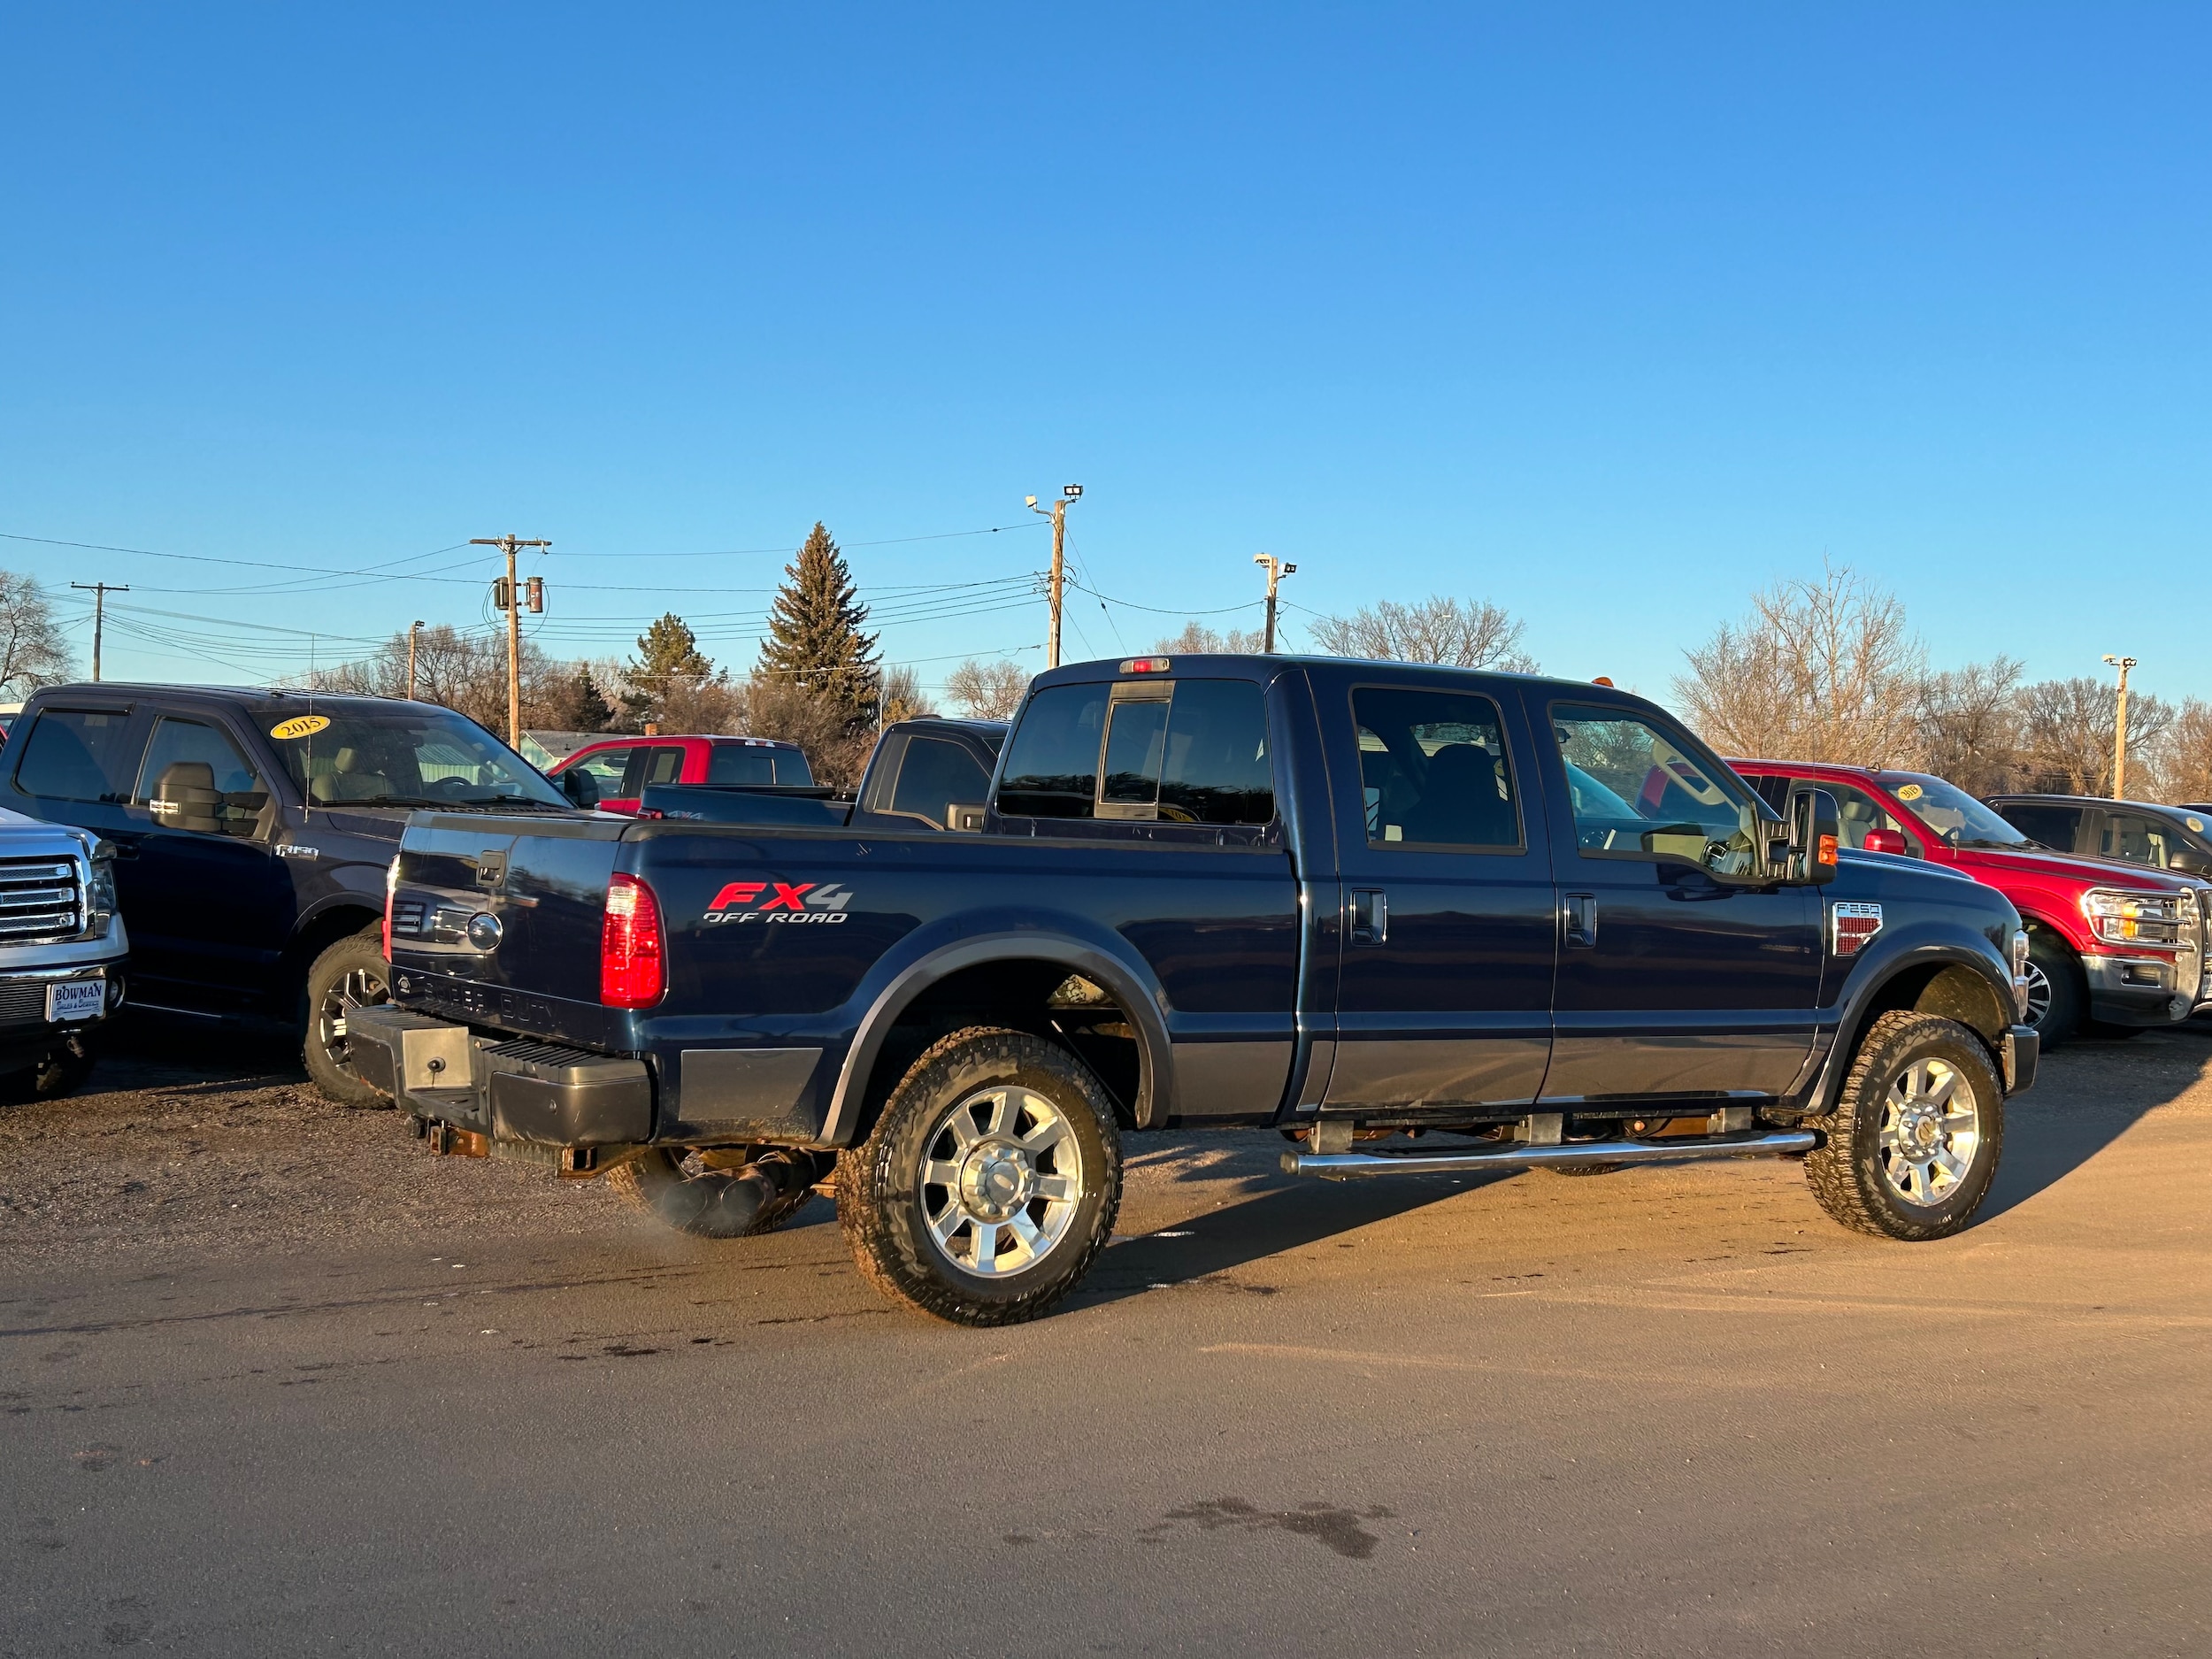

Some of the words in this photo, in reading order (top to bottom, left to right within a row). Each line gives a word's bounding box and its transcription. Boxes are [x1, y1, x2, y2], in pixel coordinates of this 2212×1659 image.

[280, 717, 321, 736] 2015
[707, 881, 854, 910] FX4
[703, 912, 760, 923] OFF
[764, 912, 848, 924] ROAD
[55, 984, 102, 1001] BOWMAN
